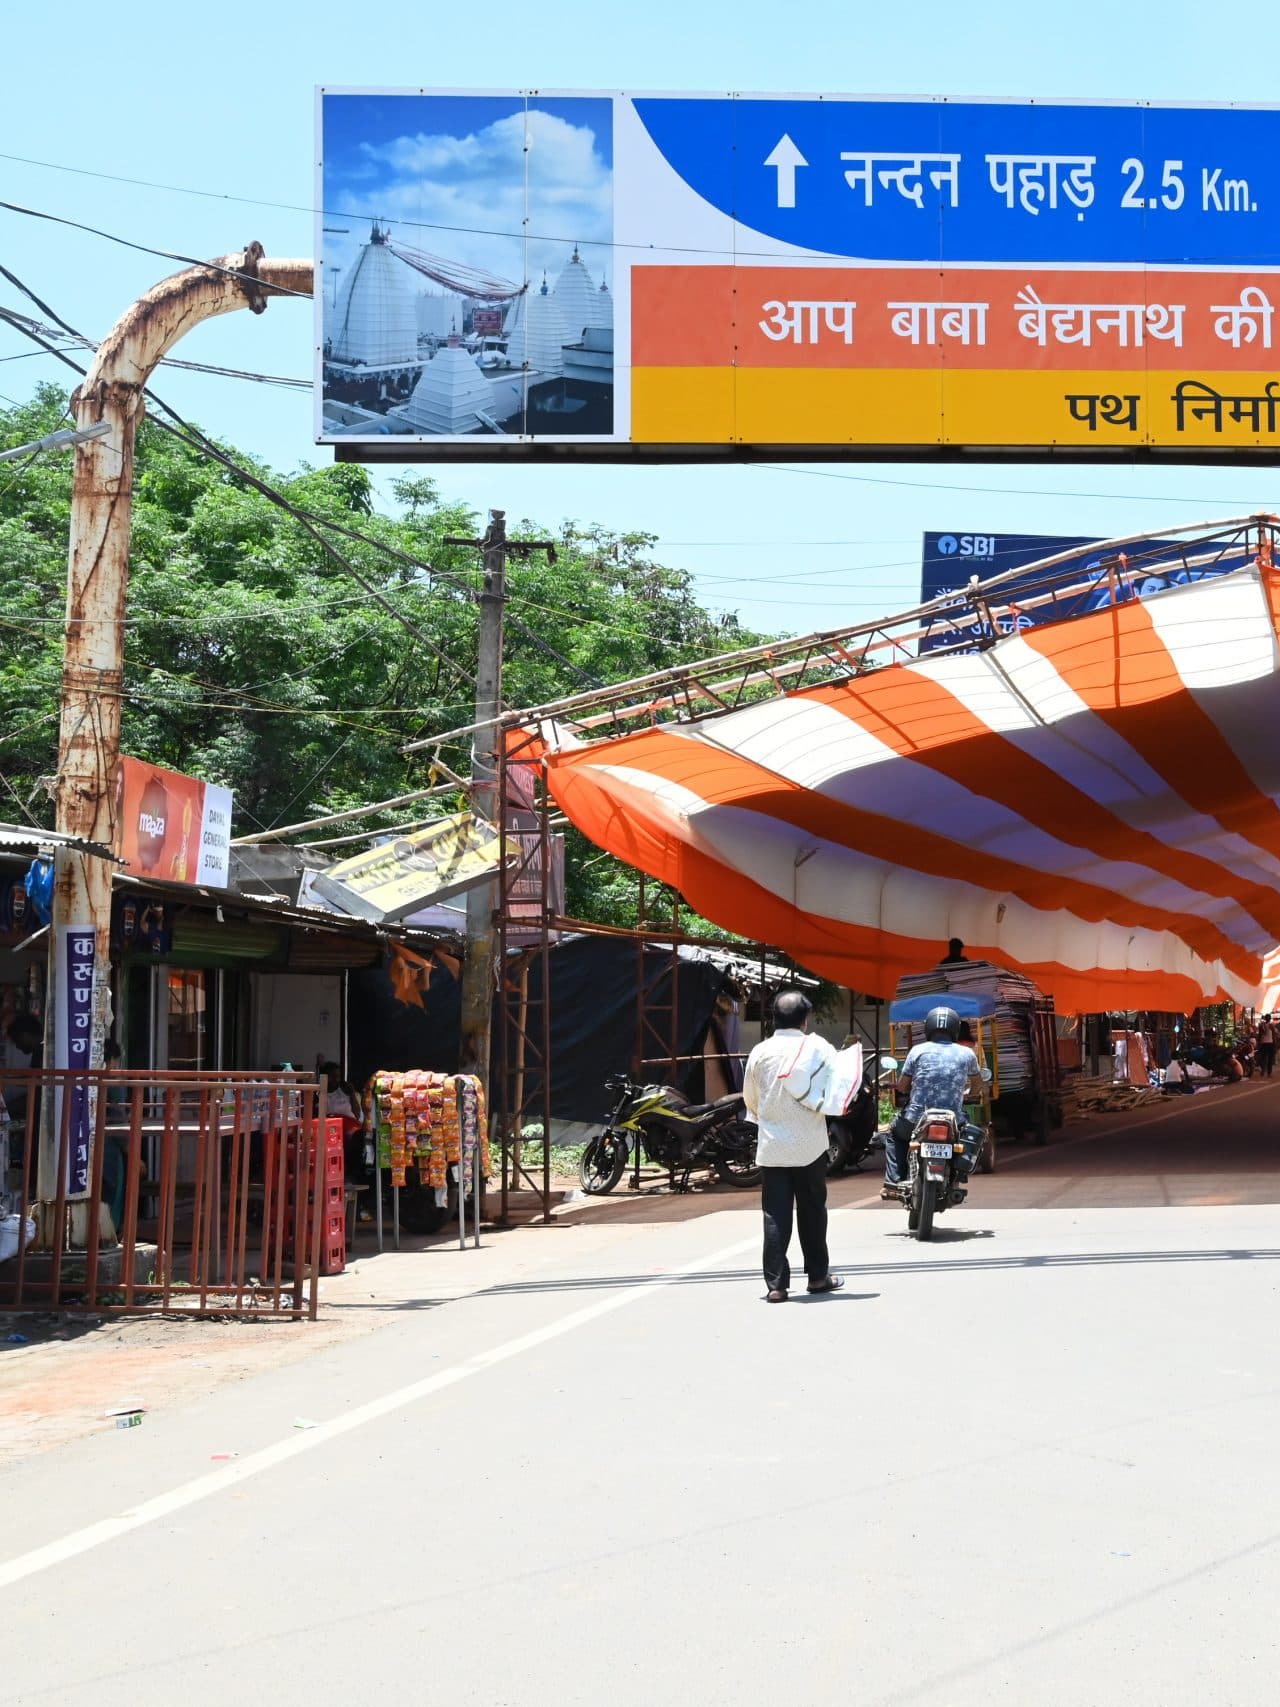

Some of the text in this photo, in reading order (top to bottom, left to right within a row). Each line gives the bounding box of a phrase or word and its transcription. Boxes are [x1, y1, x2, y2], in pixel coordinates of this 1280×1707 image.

[841, 152, 1258, 222] नन्दन पहाड़ 2.5 Km.
[758, 300, 857, 345] आप
[887, 302, 990, 346] बाबा
[1013, 284, 1186, 348] बैद्यनाथ
[1209, 286, 1275, 349] की
[1065, 394, 1140, 432] पथ
[959, 535, 995, 556] SBI
[203, 831, 227, 849] GENERAL
[204, 855, 223, 871] STORE
